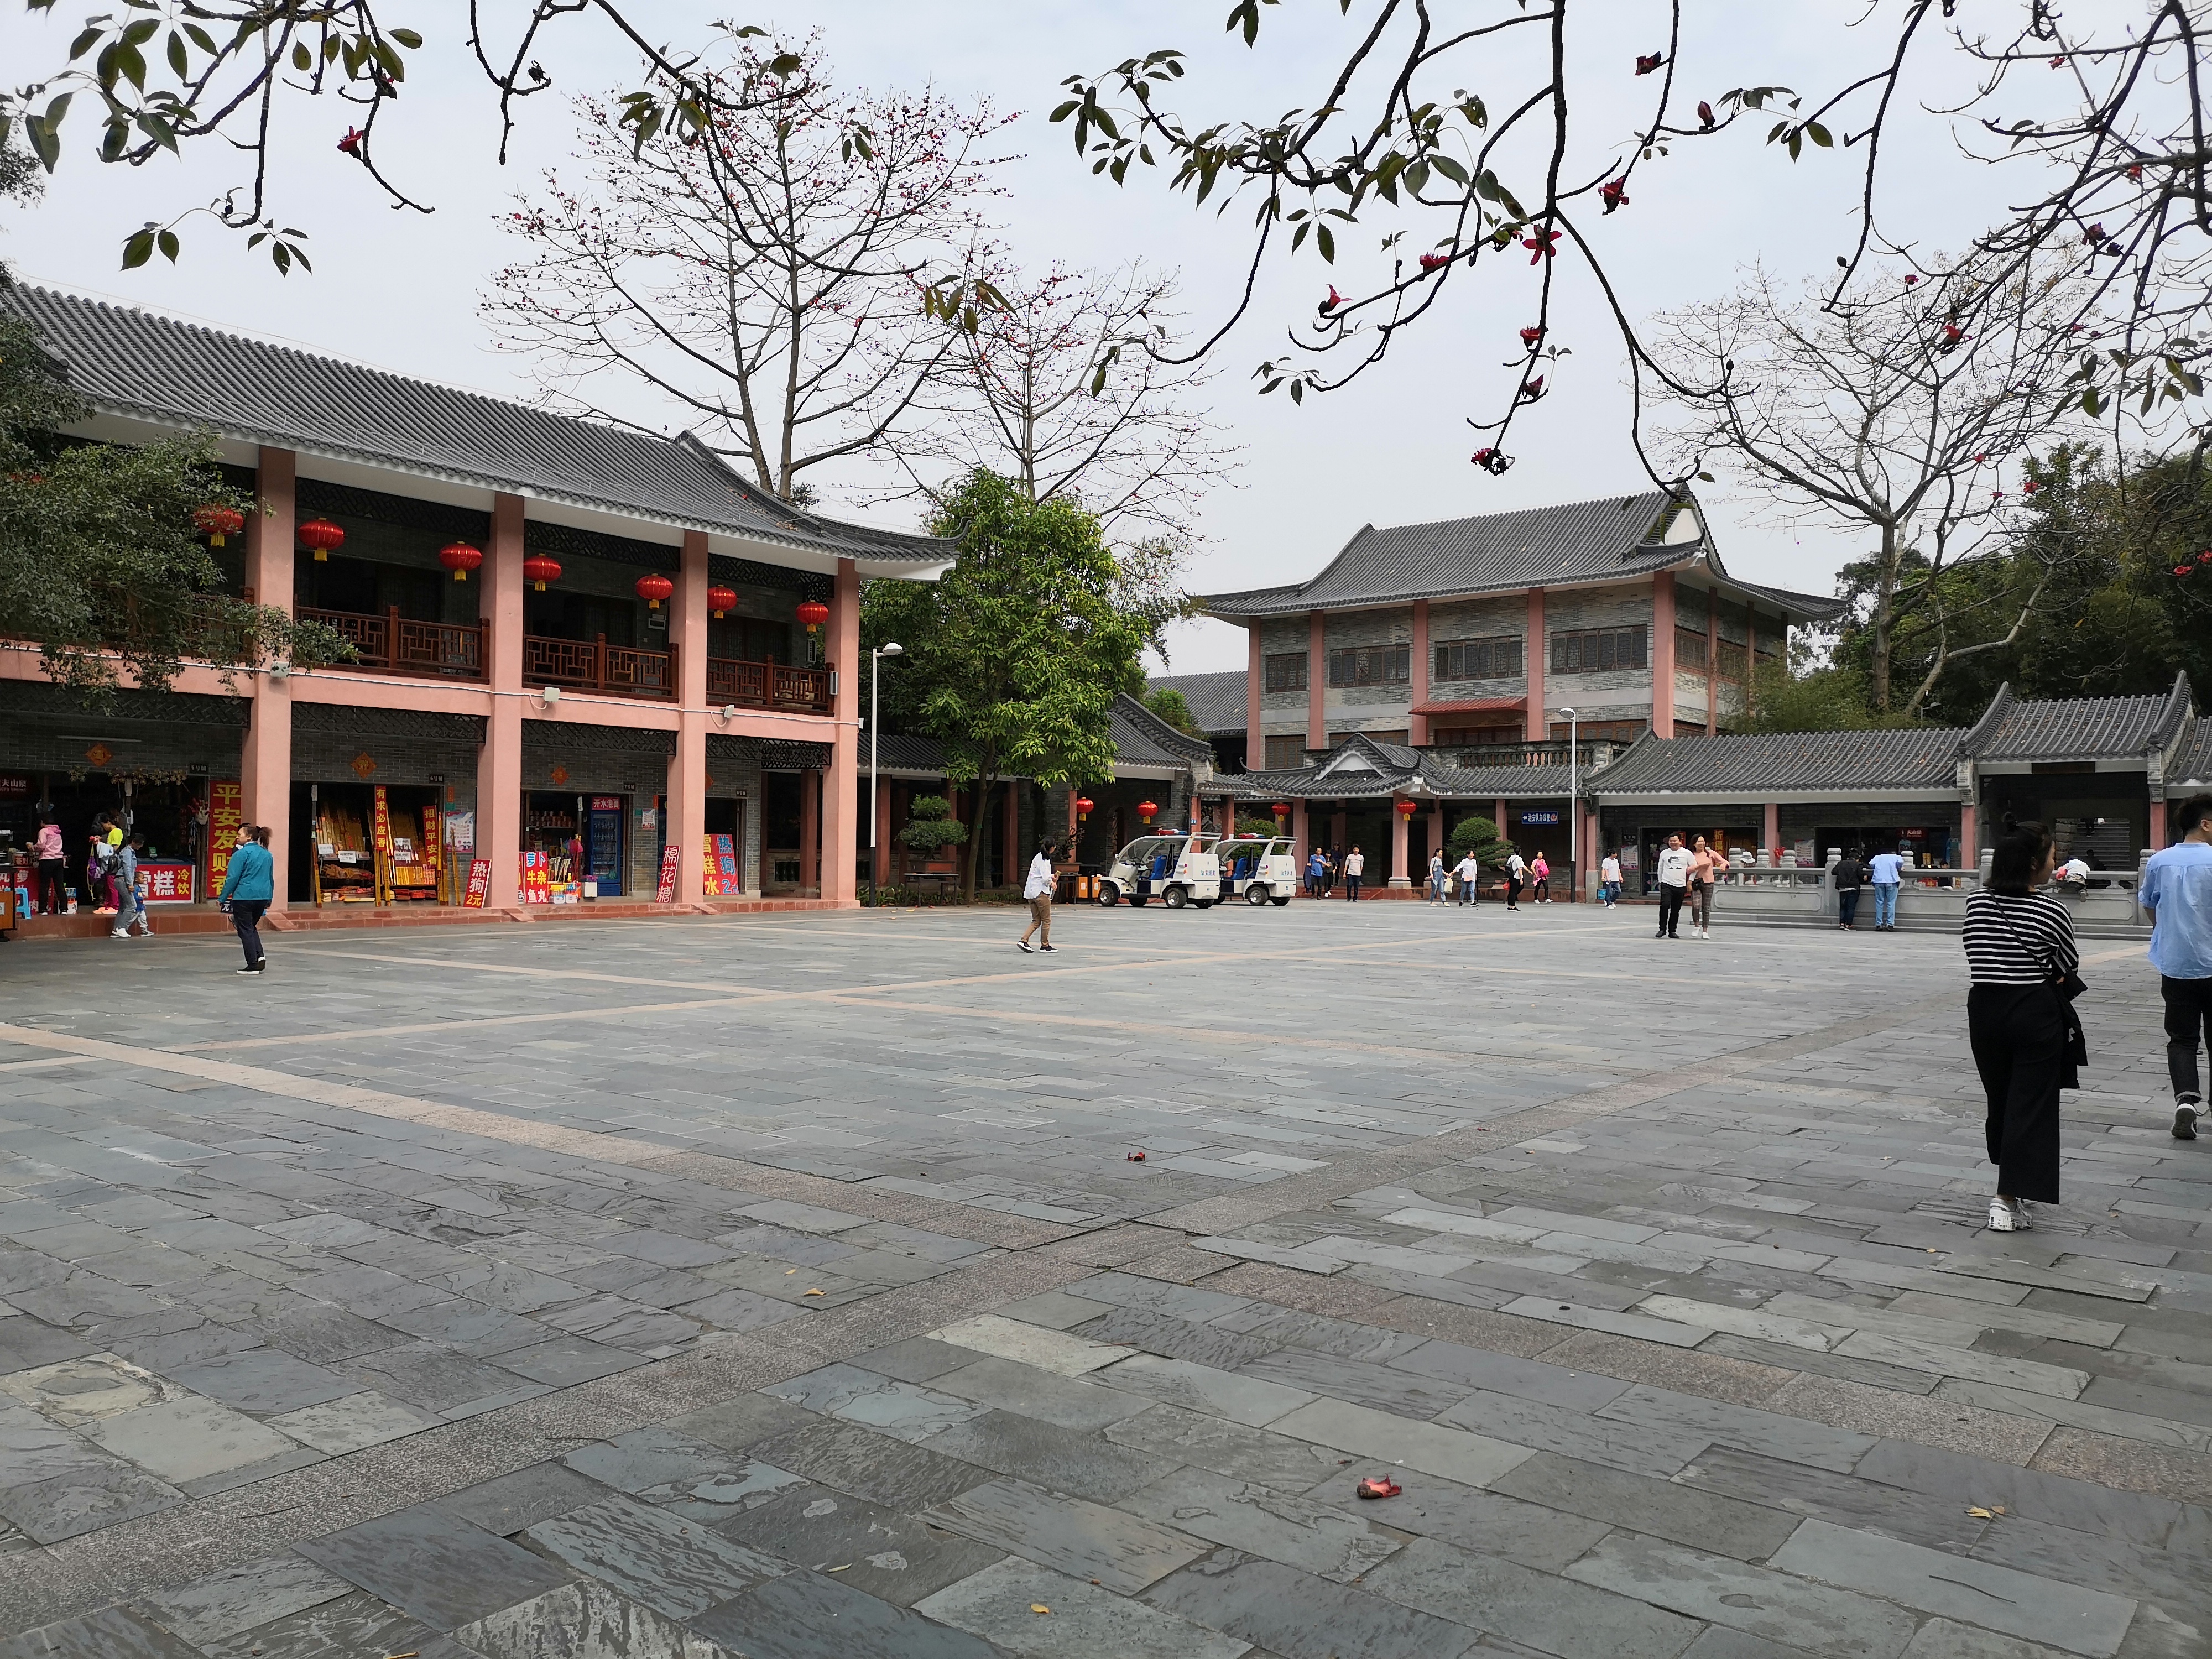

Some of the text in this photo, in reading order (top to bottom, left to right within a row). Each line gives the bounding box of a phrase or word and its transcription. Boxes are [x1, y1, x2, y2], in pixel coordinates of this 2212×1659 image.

[593, 799, 619, 808] 开水泡面
[376, 788, 386, 848] 有求必应香
[526, 851, 546, 868] 萝卜
[177, 868, 190, 895] 冷饮
[469, 861, 487, 894] 热狗
[526, 869, 547, 885] 牛杂
[656, 846, 678, 903] 棉花糖
[466, 894, 482, 906] 2元
[527, 888, 547, 903] 鱼丸
